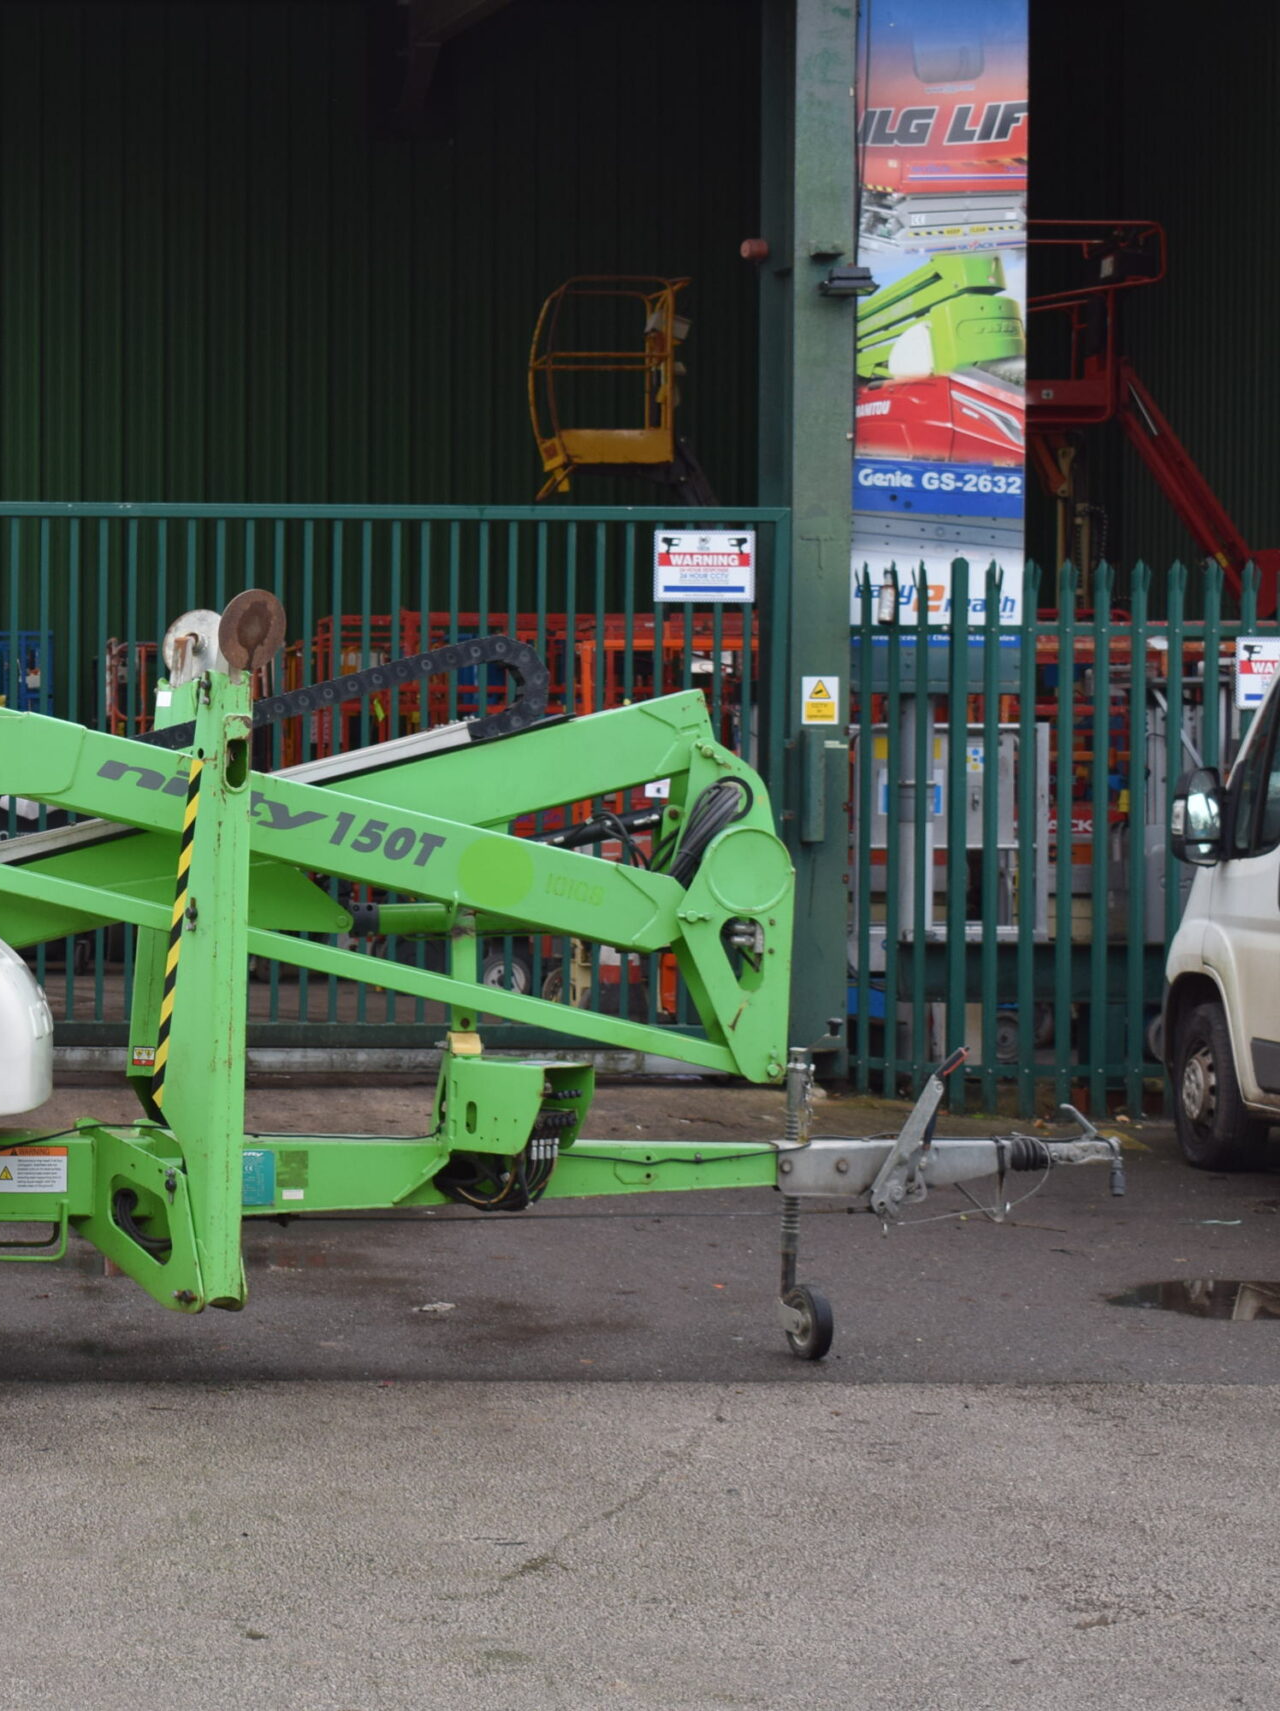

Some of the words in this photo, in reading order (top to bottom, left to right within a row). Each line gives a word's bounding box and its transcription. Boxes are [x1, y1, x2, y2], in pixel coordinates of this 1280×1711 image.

[858, 469, 912, 487] Genie
[922, 472, 1022, 494] GS-2632
[670, 555, 738, 566] WARNING
[329, 812, 447, 868] 150T
